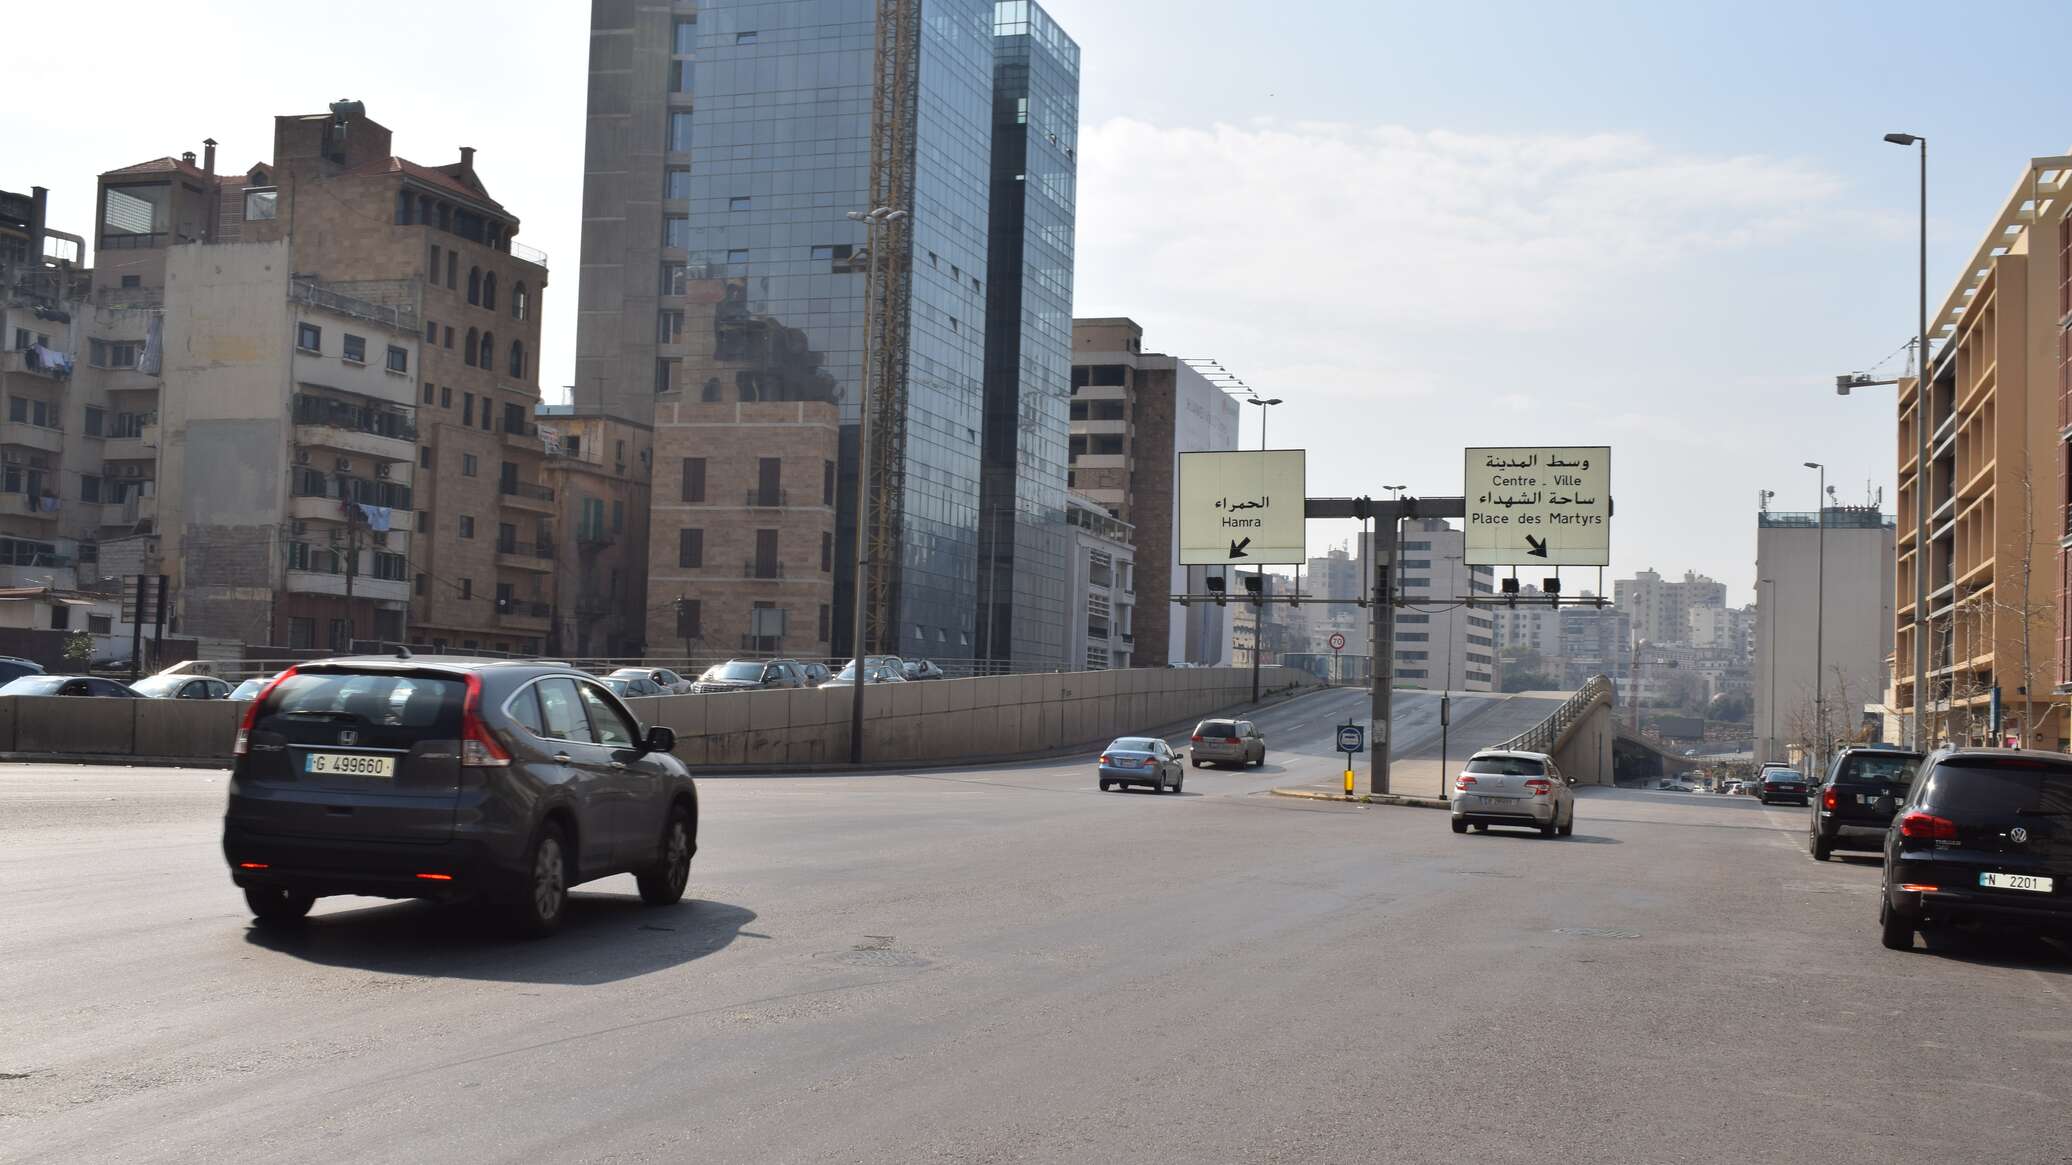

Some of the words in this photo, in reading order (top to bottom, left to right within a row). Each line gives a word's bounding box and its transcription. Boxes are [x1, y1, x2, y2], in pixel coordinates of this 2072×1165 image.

[1486, 454, 1537, 471] المدينة
[1546, 454, 1589, 470] وسط
[1492, 475, 1536, 486] Centre
[1554, 475, 1582, 486] Ville
[1215, 496, 1269, 512] الحمراء
[1480, 491, 1541, 508] الشهداء
[1548, 491, 1595, 505] ساحة
[1222, 516, 1261, 527] Hamra
[1472, 513, 1509, 524] Place
[1518, 513, 1541, 524] des
[1549, 513, 1602, 526] Martyrs
[1333, 637, 1343, 646] 70
[316, 755, 326, 771] G
[333, 756, 384, 774] 499660
[1988, 873, 1996, 886] N
[2009, 875, 2037, 890] 2201
